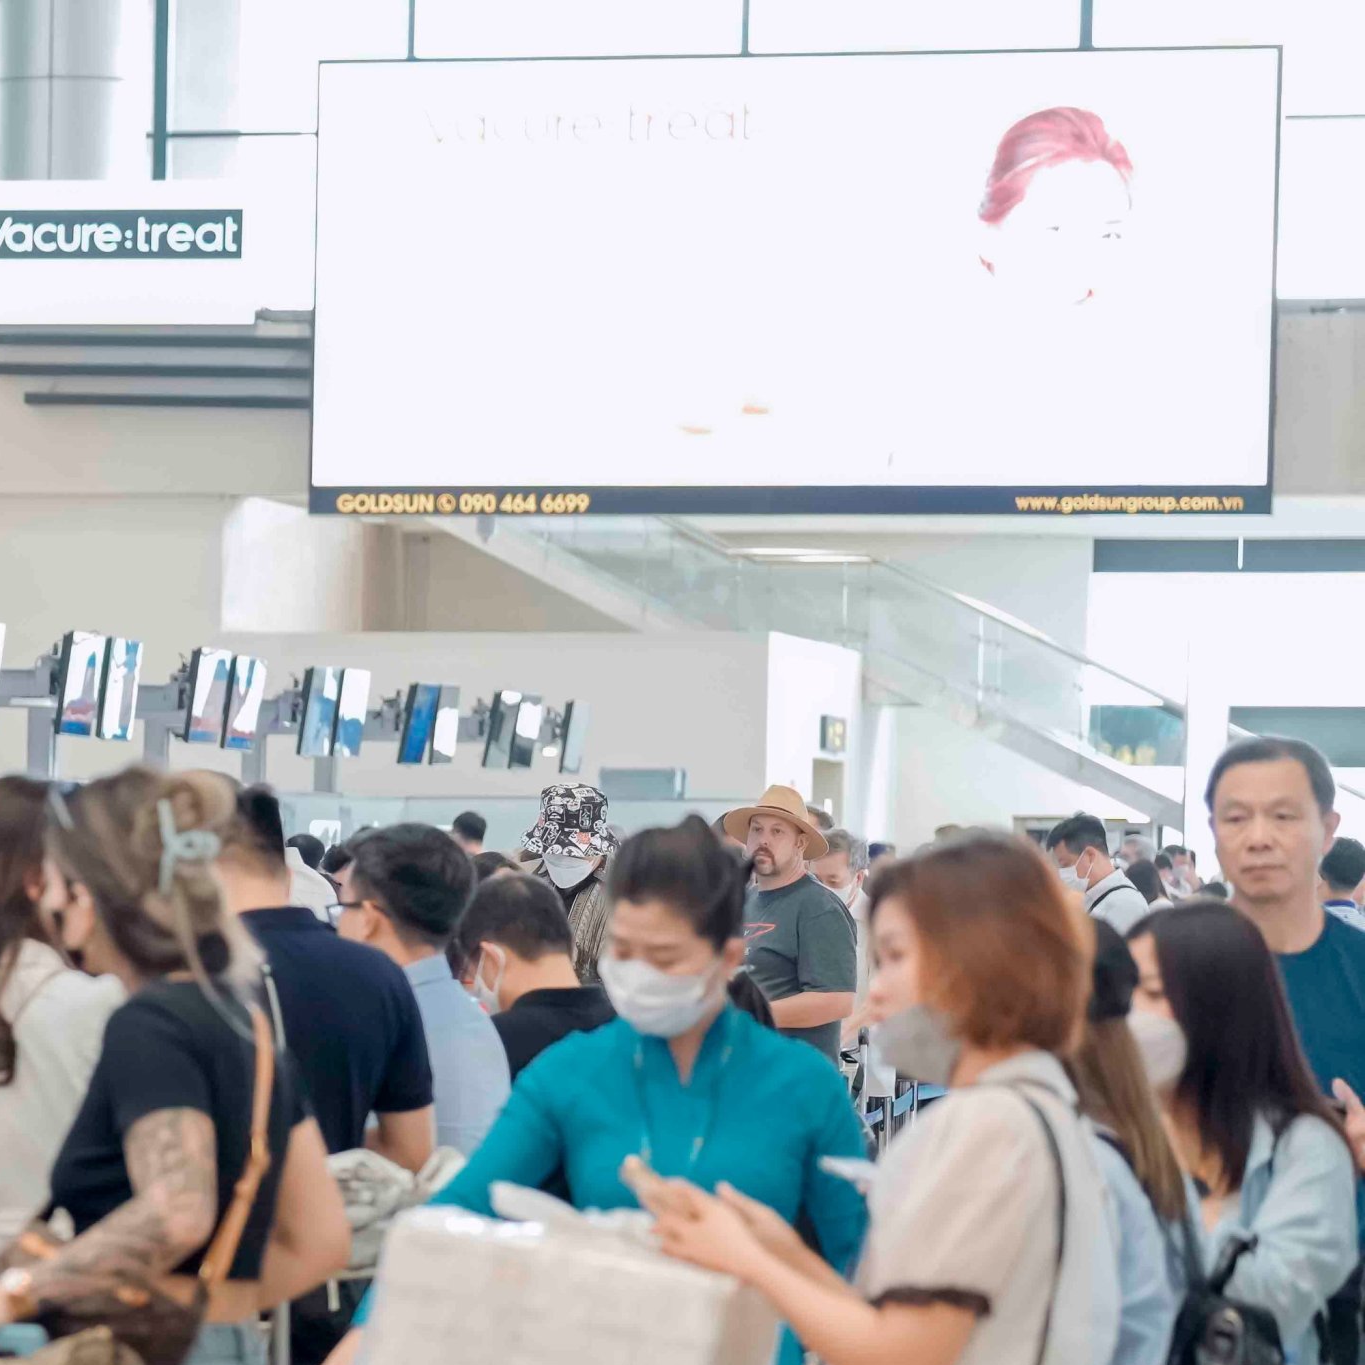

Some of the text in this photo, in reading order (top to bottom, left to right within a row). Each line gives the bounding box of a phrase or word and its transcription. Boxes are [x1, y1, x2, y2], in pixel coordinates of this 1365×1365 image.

[336, 493, 590, 513] GOLDSUN 090 464 6699
[1014, 493, 1245, 514] www.goldsungroup.com.vn
